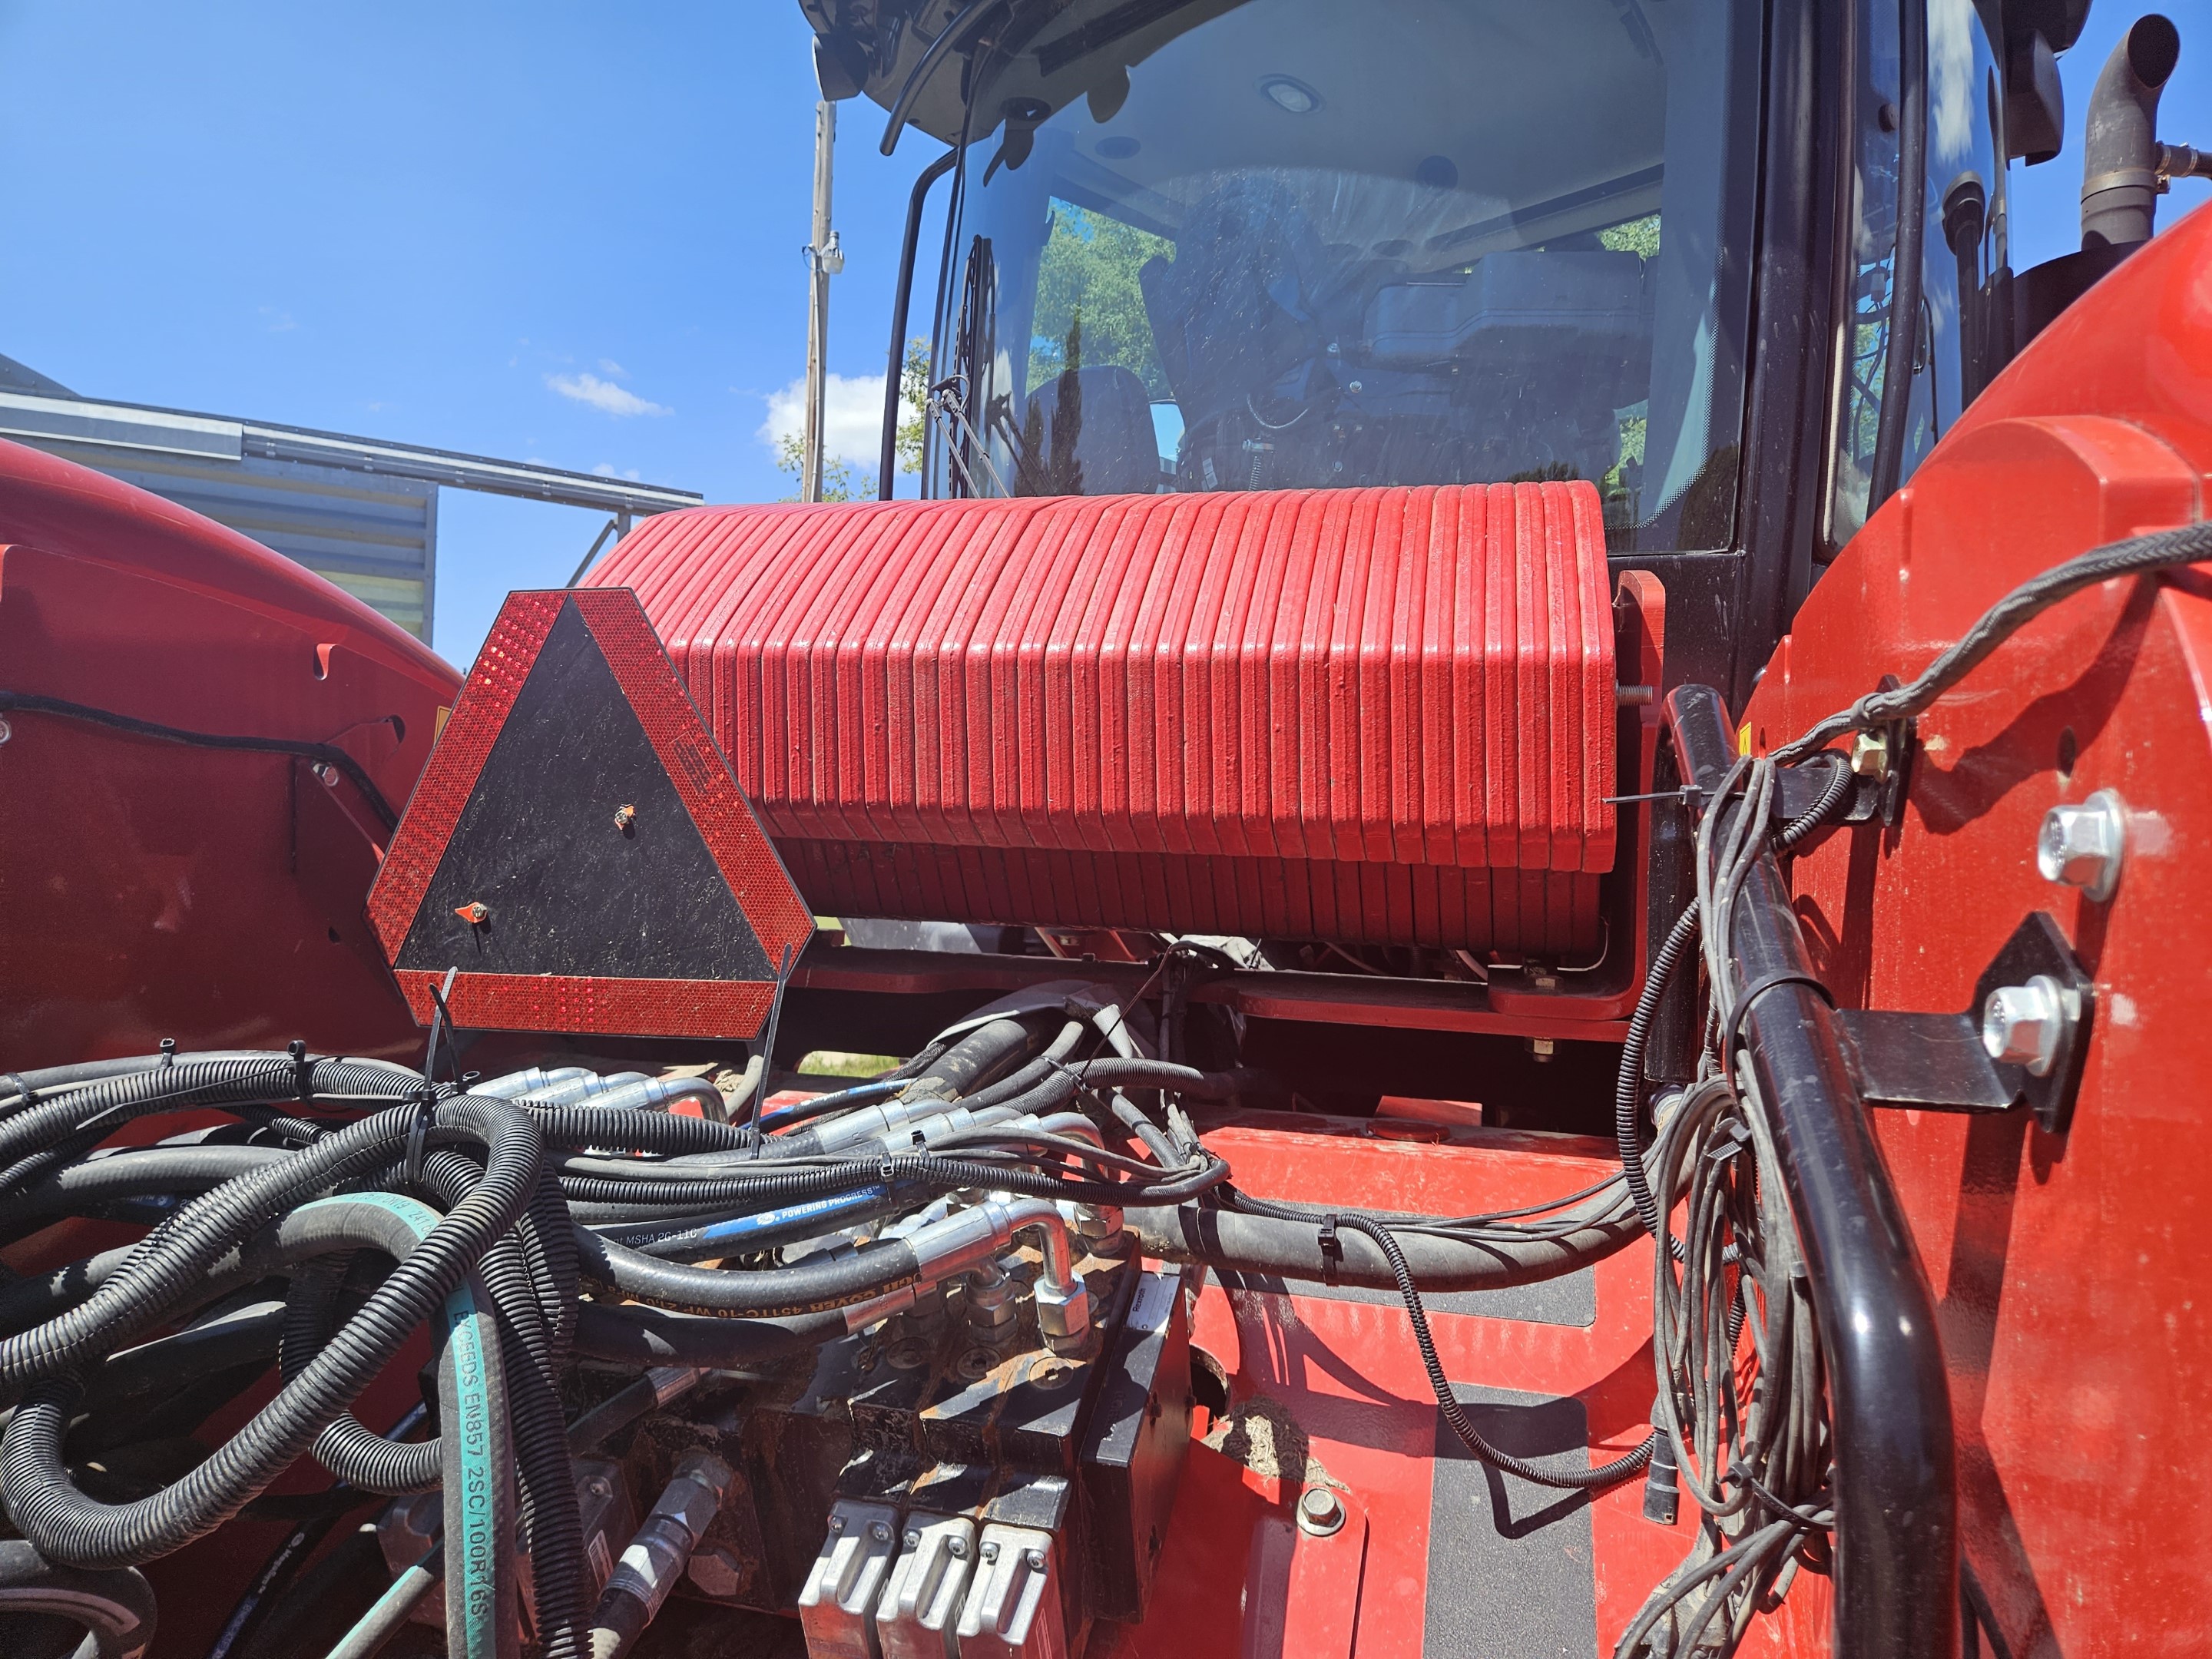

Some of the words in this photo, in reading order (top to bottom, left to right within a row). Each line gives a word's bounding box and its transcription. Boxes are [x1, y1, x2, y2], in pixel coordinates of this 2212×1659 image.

[626, 1225, 656, 1245] MSHA
[782, 1200, 828, 1220] POWERING
[607, 1284, 641, 1302] MPa
[810, 1288, 875, 1312] COVER
[1132, 1287, 1146, 1313] Rexroth
[684, 1304, 712, 1315] WP
[717, 1305, 803, 1318] 451TC-10
[452, 1310, 479, 1387] EXCEEDS
[463, 1392, 484, 1456] EN857
[466, 1465, 488, 1616] 2SC/100R16S
